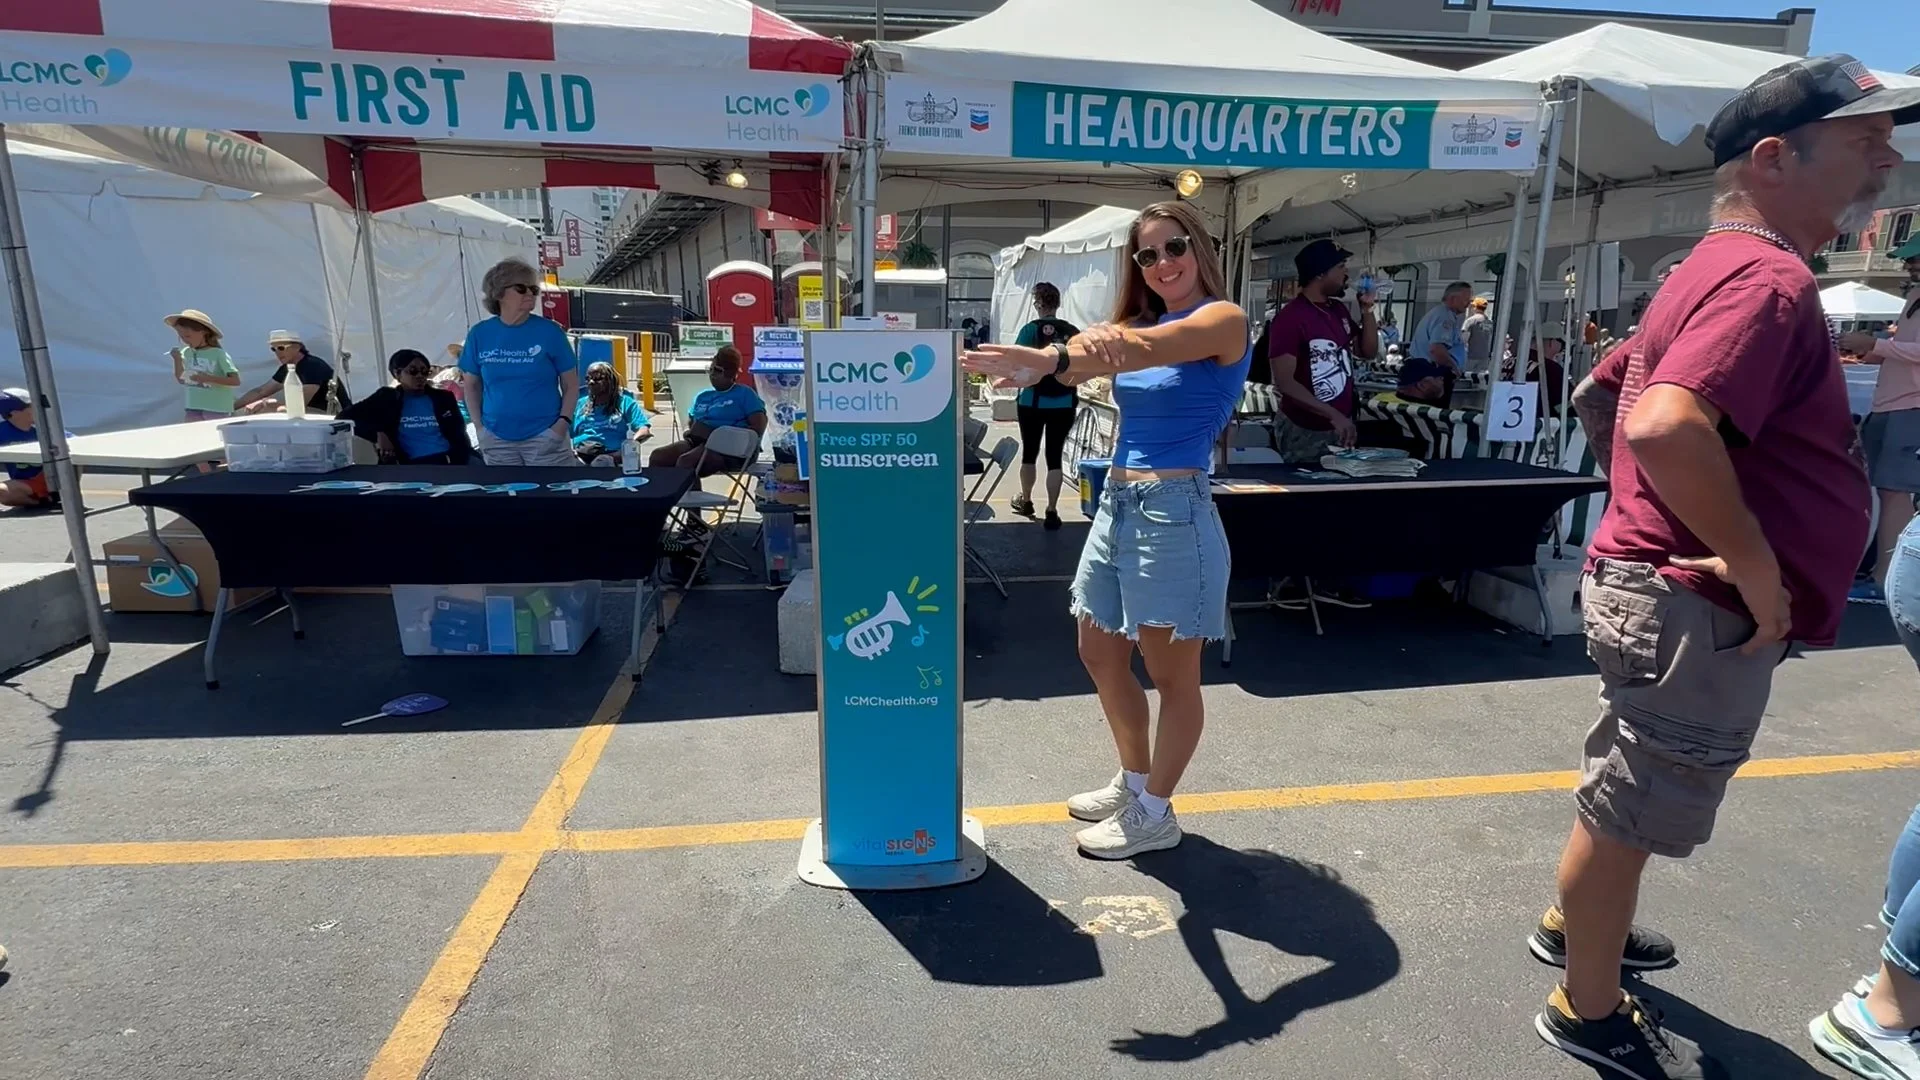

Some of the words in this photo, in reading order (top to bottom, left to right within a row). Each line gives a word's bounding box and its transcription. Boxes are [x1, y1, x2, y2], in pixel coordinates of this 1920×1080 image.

[0, 61, 82, 85] LCMC
[1, 90, 98, 114] Health
[288, 61, 465, 127] FIRST
[504, 71, 596, 132] AID
[725, 95, 790, 116] LCMC
[727, 121, 799, 141] Health
[899, 125, 917, 136] FRENCH
[941, 127, 963, 139] FESTIVAL
[1045, 91, 1405, 159] HEADQUARTERS
[568, 220, 578, 255] PARK
[479, 349, 499, 359] LCMC
[500, 349, 528, 357] Health
[817, 362, 888, 383] LCMC
[818, 390, 898, 411] Health
[400, 415, 419, 423] CMC
[1502, 396, 1524, 428] 3
[819, 433, 857, 446] Free
[860, 433, 892, 446] SPF
[896, 433, 917, 446] 50
[820, 452, 939, 467] sunscreen
[845, 696, 938, 707] LCMChealth.org
[1609, 1043, 1636, 1058] FILA
